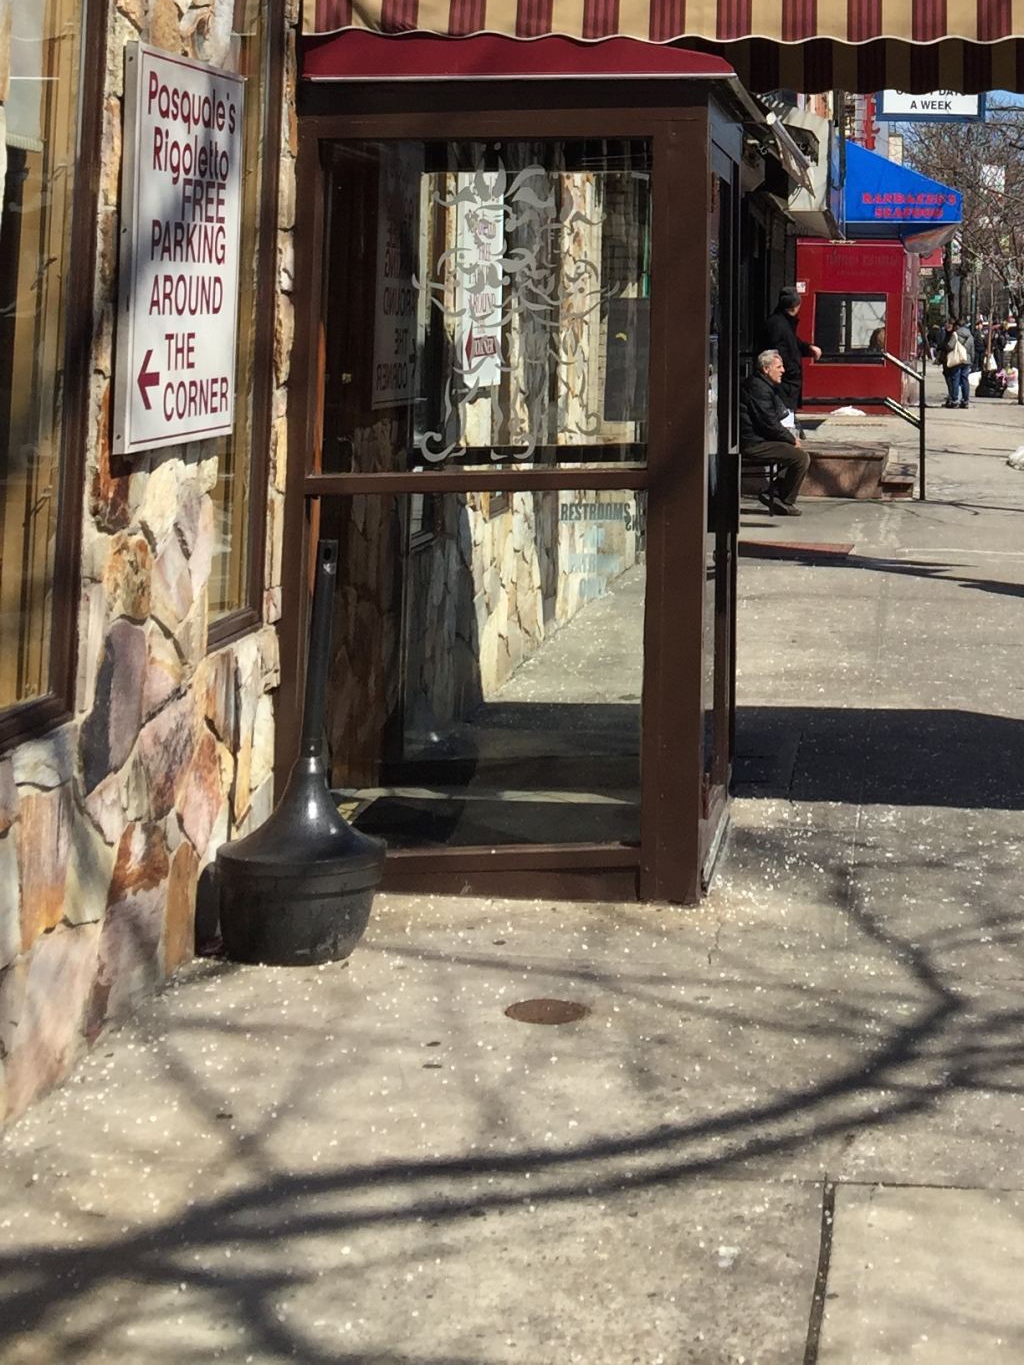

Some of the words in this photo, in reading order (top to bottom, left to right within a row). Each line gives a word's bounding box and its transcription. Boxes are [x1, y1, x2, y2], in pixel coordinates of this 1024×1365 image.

[148, 70, 236, 135] Pasquale's
[910, 100, 917, 110] A
[921, 100, 952, 110] WEEK
[153, 126, 229, 185] Rigoletto
[180, 178, 227, 224] FREE
[151, 219, 226, 266] PARKING
[149, 273, 224, 316] AROUND
[165, 331, 196, 371] THE
[163, 376, 228, 422] CORNER
[560, 502, 631, 521] RESTROOMS
